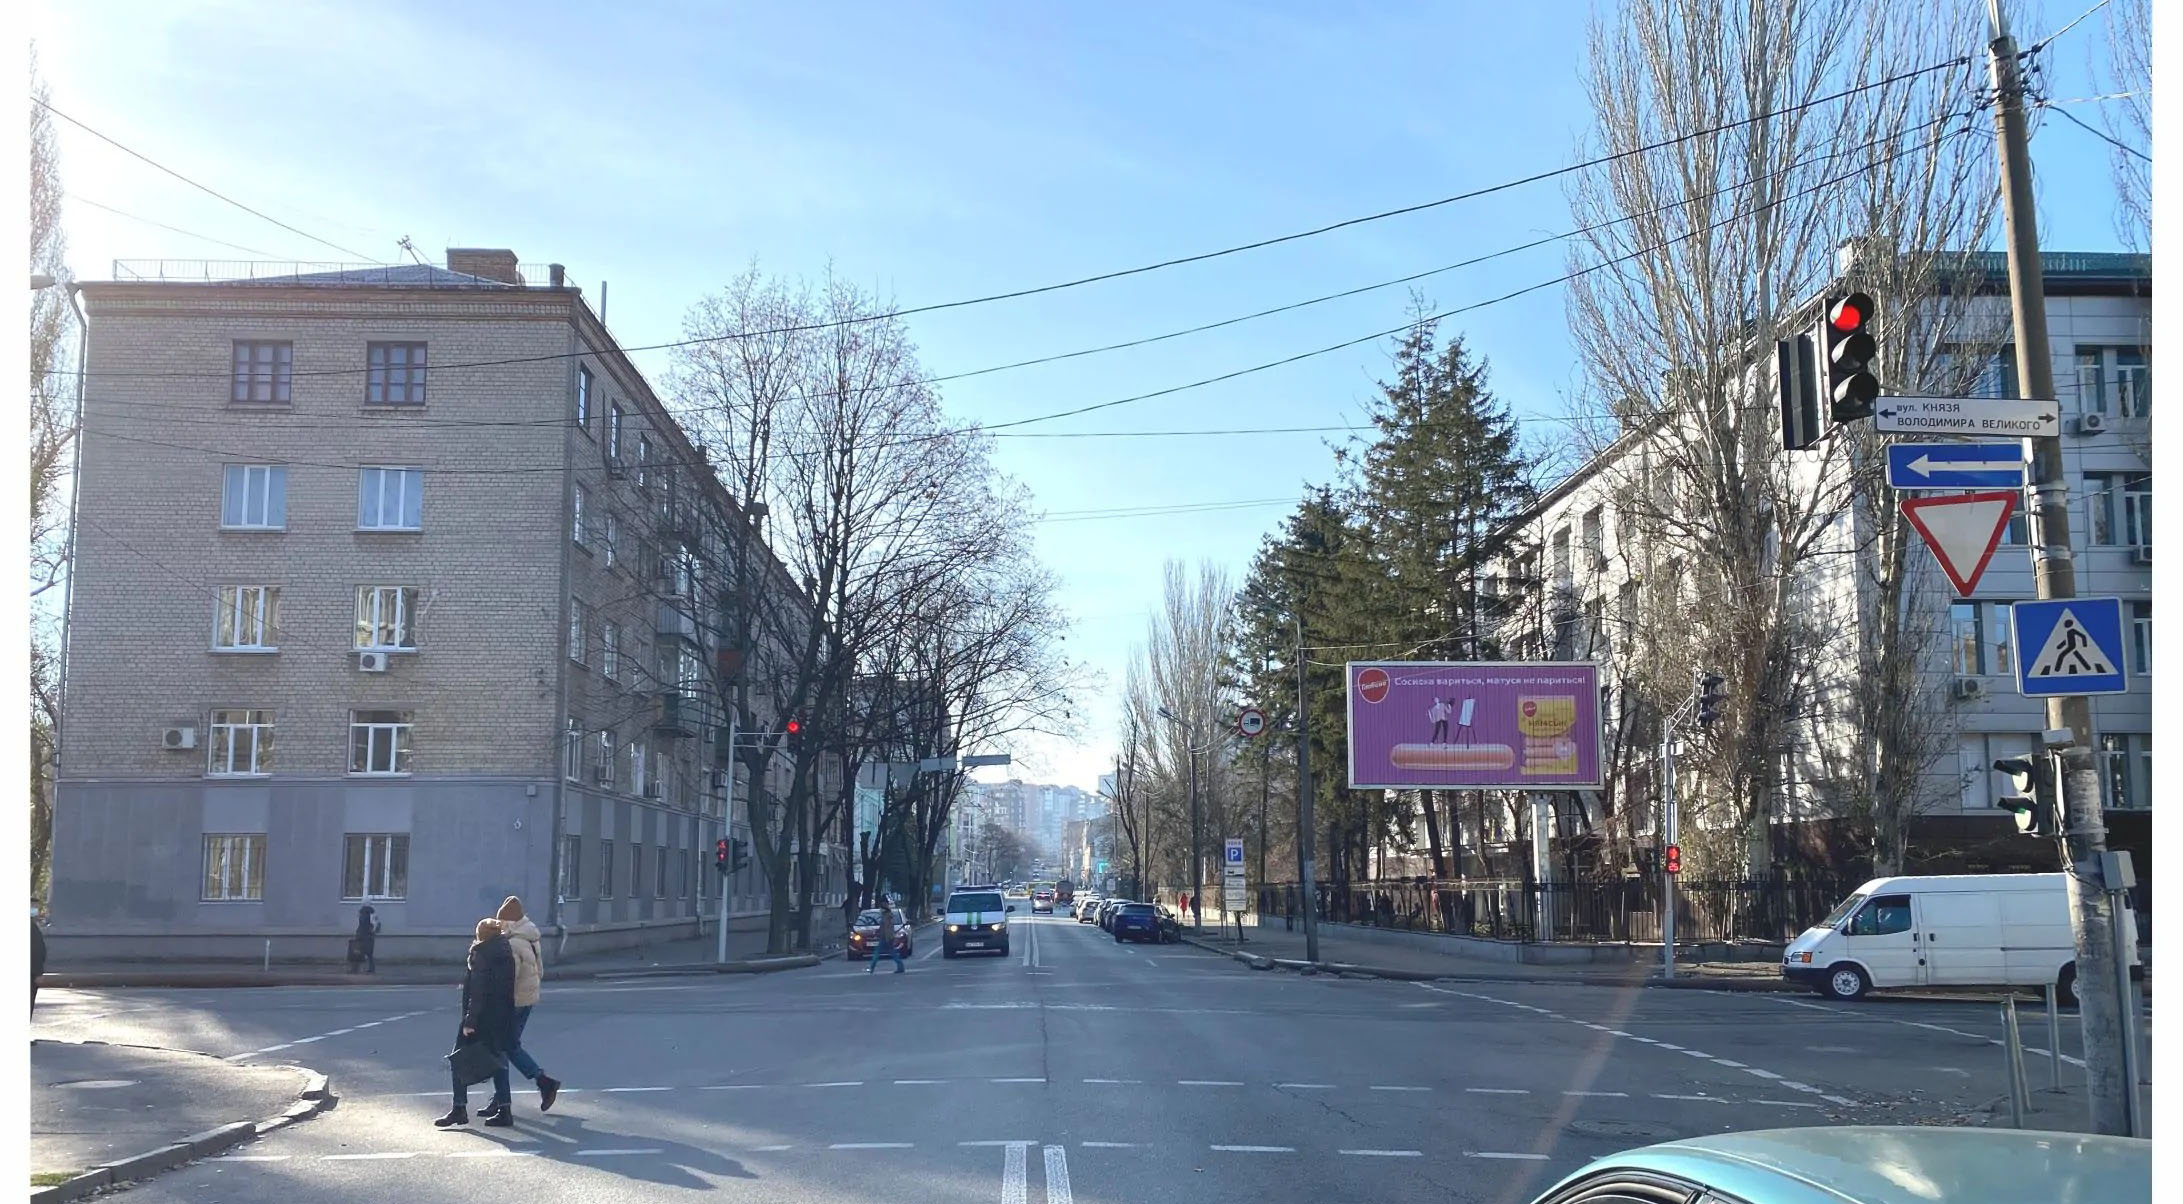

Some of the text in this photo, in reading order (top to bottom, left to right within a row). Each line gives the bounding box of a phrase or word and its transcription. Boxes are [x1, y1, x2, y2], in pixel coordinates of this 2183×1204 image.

[1896, 403, 1960, 414] вул. КНЯЗЯ
[1897, 417, 2041, 430] ВОЛОДИМИРА ВЕЛИКОГО
[1394, 677, 1434, 686] Сосиска
[1436, 677, 1484, 687] вариться,
[1486, 677, 1521, 685] матуся
[1537, 676, 1585, 686] париться!
[1230, 849, 1239, 860] P
